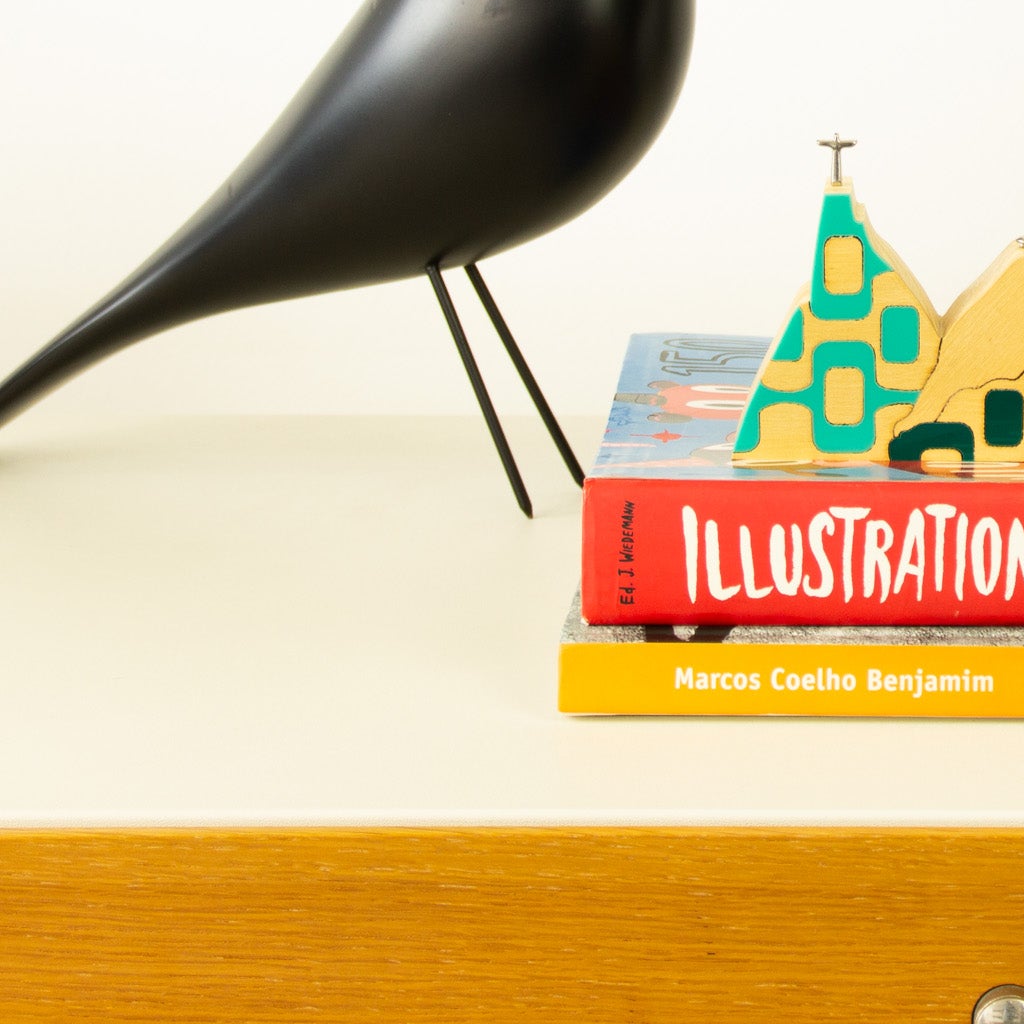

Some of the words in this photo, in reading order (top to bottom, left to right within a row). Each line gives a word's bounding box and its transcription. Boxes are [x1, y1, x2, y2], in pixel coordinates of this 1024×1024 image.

[618, 500, 635, 563] WIEDEMANN
[617, 567, 635, 578] J.
[618, 582, 636, 606] Ed.
[674, 667, 761, 691] Marcos
[770, 667, 857, 691] Coelho
[867, 668, 994, 699] Benjamim
